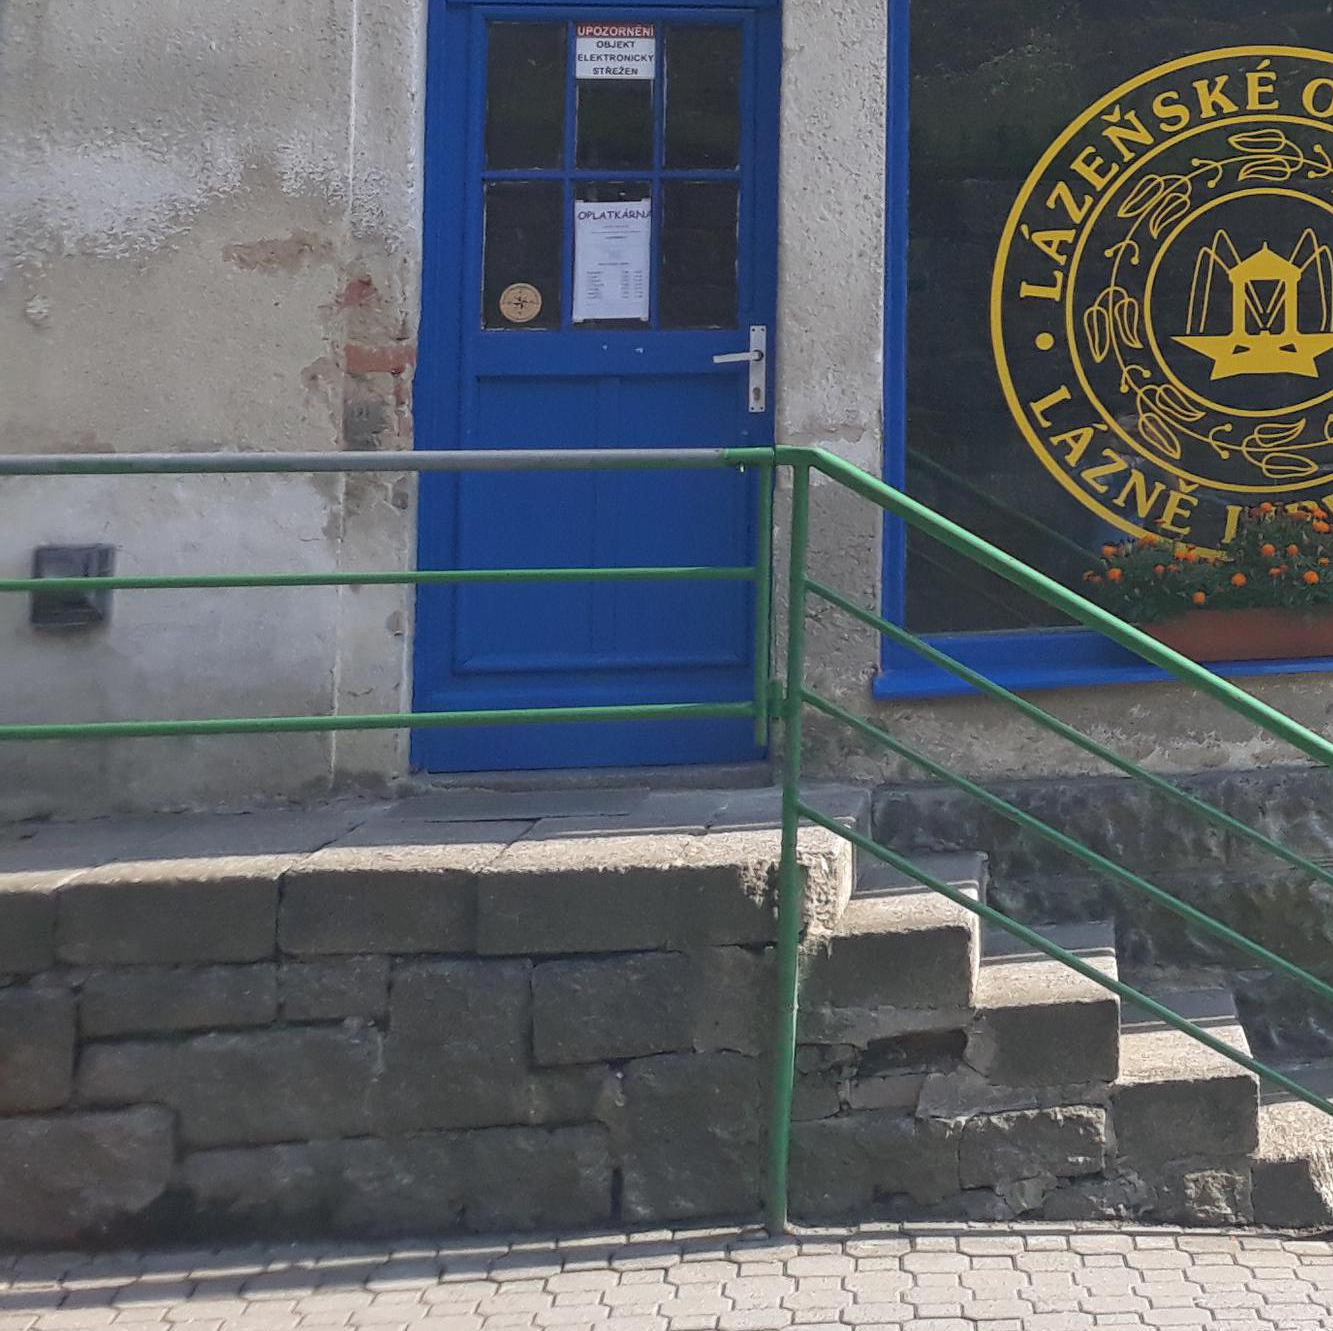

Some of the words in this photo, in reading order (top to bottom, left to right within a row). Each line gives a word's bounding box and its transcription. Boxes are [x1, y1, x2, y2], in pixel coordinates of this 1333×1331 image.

[592, 66, 638, 76] STŘEŽEN
[596, 40, 635, 49] OBJEKT
[1019, 58, 1281, 303] LÁZEŇSKÉ
[1030, 384, 1200, 537] LÁZNĚ
